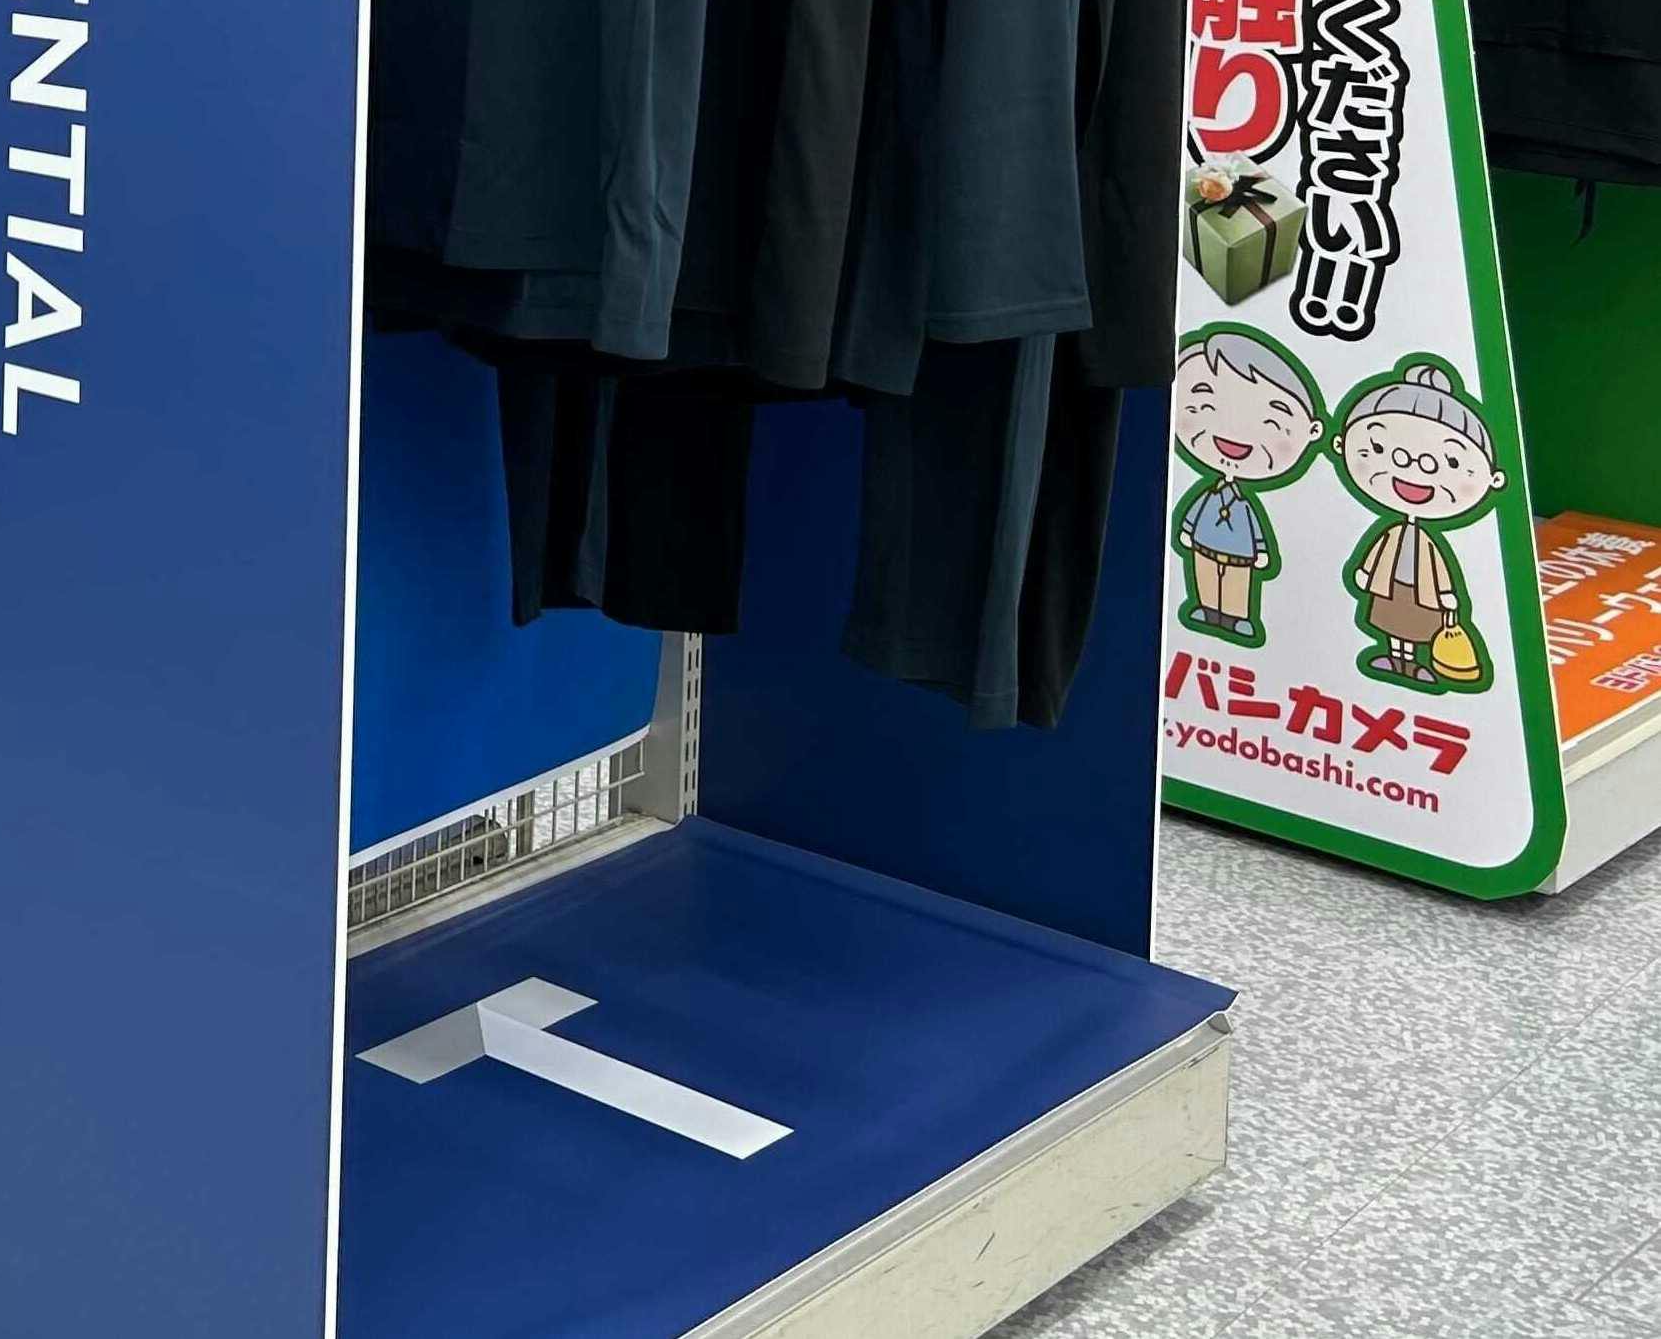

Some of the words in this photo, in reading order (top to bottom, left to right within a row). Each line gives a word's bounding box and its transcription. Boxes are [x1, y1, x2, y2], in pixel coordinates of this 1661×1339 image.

[1164, 651, 1471, 775] バシカメラ
[1164, 717, 1439, 813] .yodobashi.com
